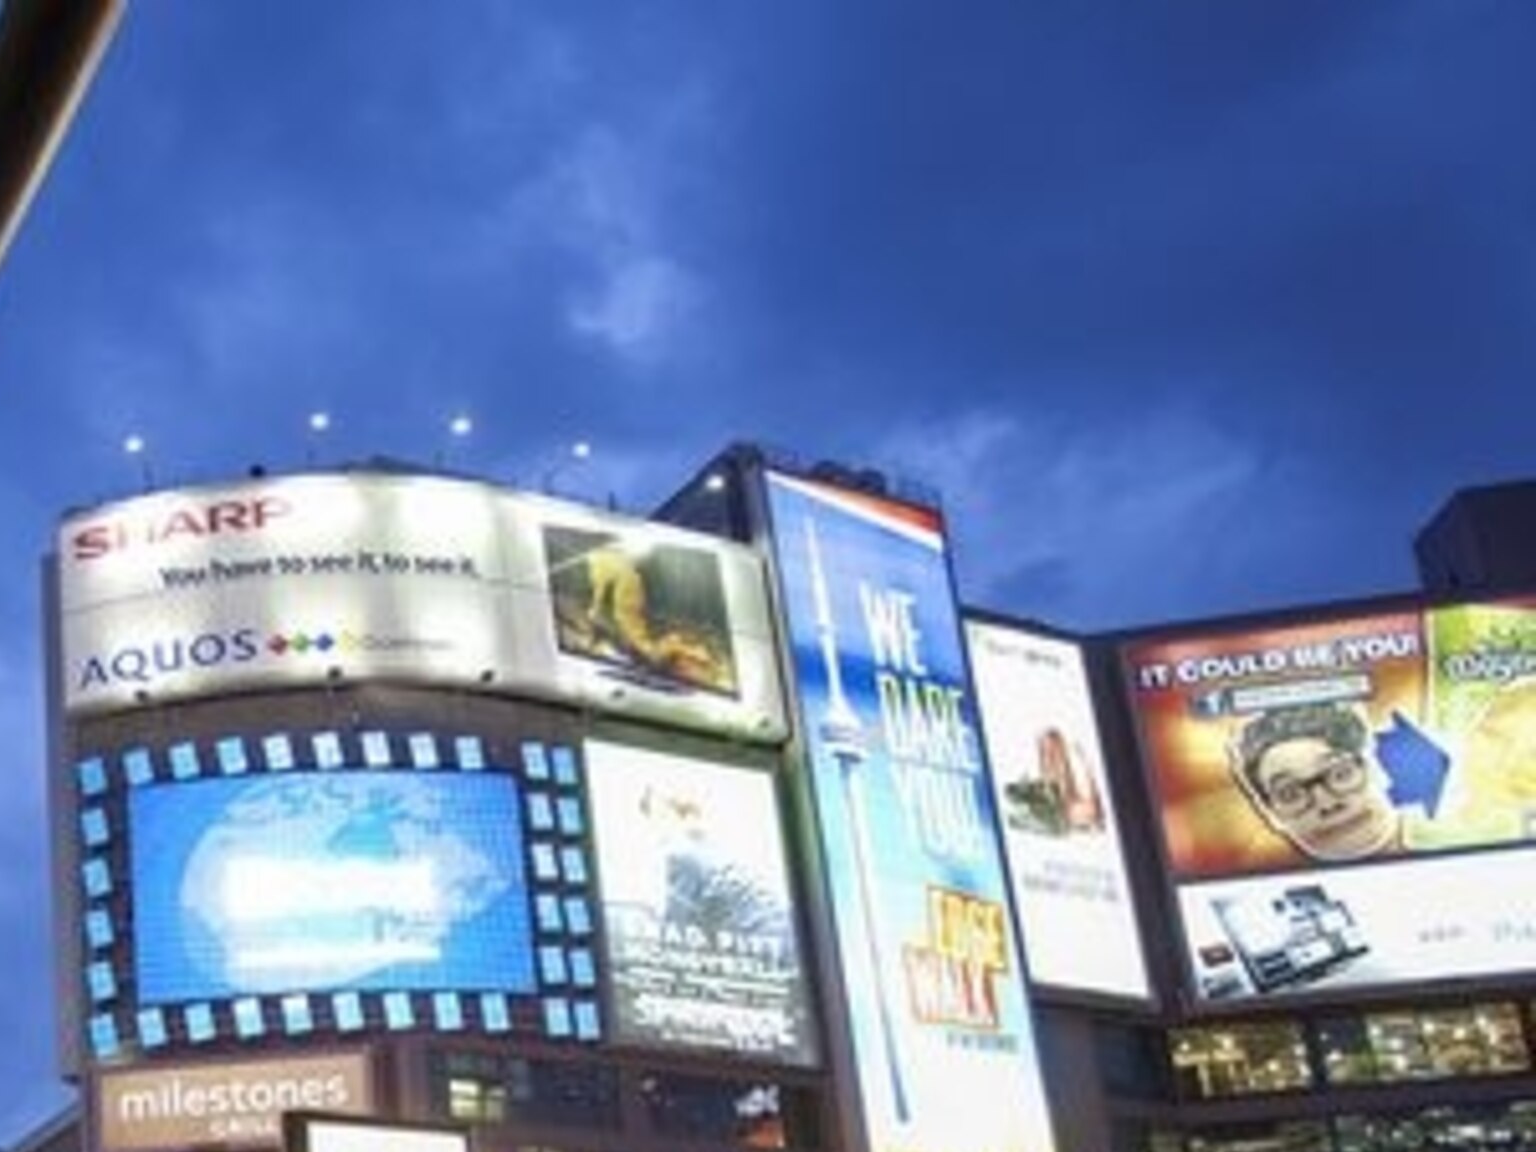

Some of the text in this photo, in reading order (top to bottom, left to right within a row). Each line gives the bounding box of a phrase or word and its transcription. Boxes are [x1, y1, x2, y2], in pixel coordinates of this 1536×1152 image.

[72, 495, 293, 562] SHARP
[159, 566, 207, 588] You
[210, 557, 272, 582] have
[277, 555, 308, 575] to
[311, 553, 353, 572] see
[382, 553, 411, 574] to
[414, 555, 457, 574] see
[859, 579, 927, 676] WE
[80, 628, 258, 688] AQUOS
[1139, 664, 1168, 688] IT
[1176, 650, 1286, 683] COULD
[120, 1074, 349, 1121] milestones
